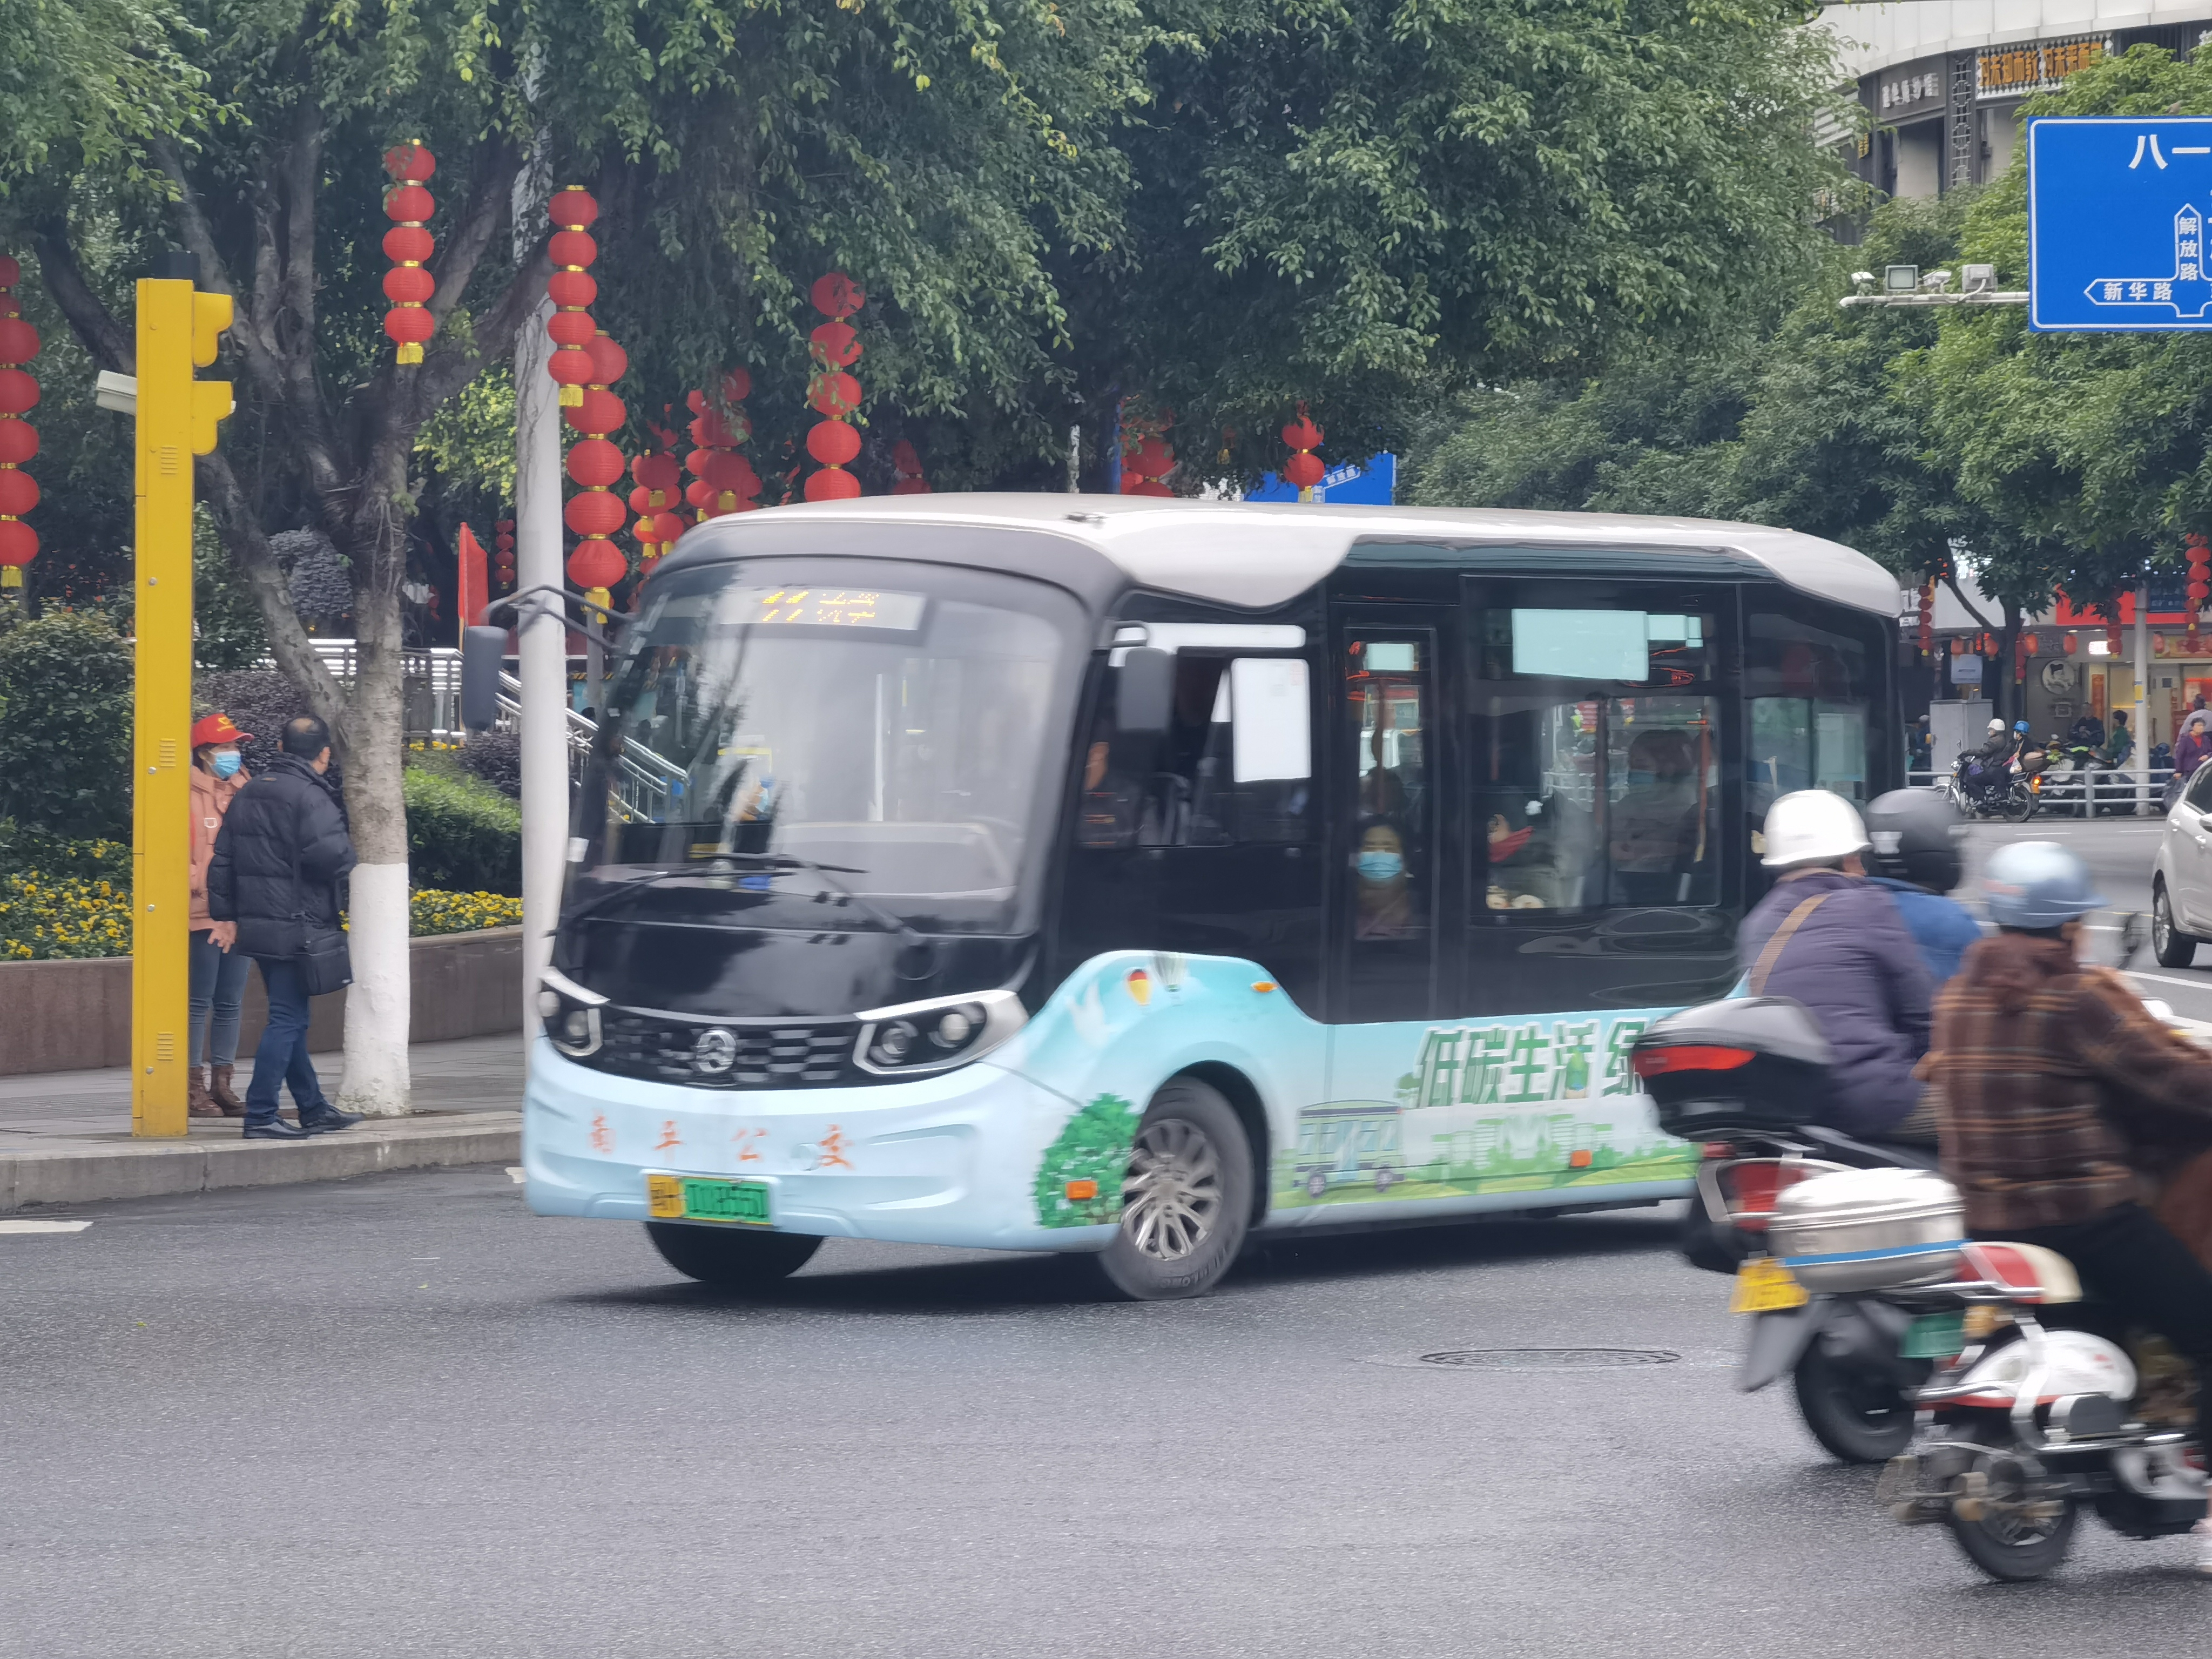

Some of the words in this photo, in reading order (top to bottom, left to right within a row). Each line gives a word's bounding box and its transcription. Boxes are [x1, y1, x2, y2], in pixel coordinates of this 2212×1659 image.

[2179, 217, 2198, 281] 解放路
[2103, 282, 2173, 301] 新华路
